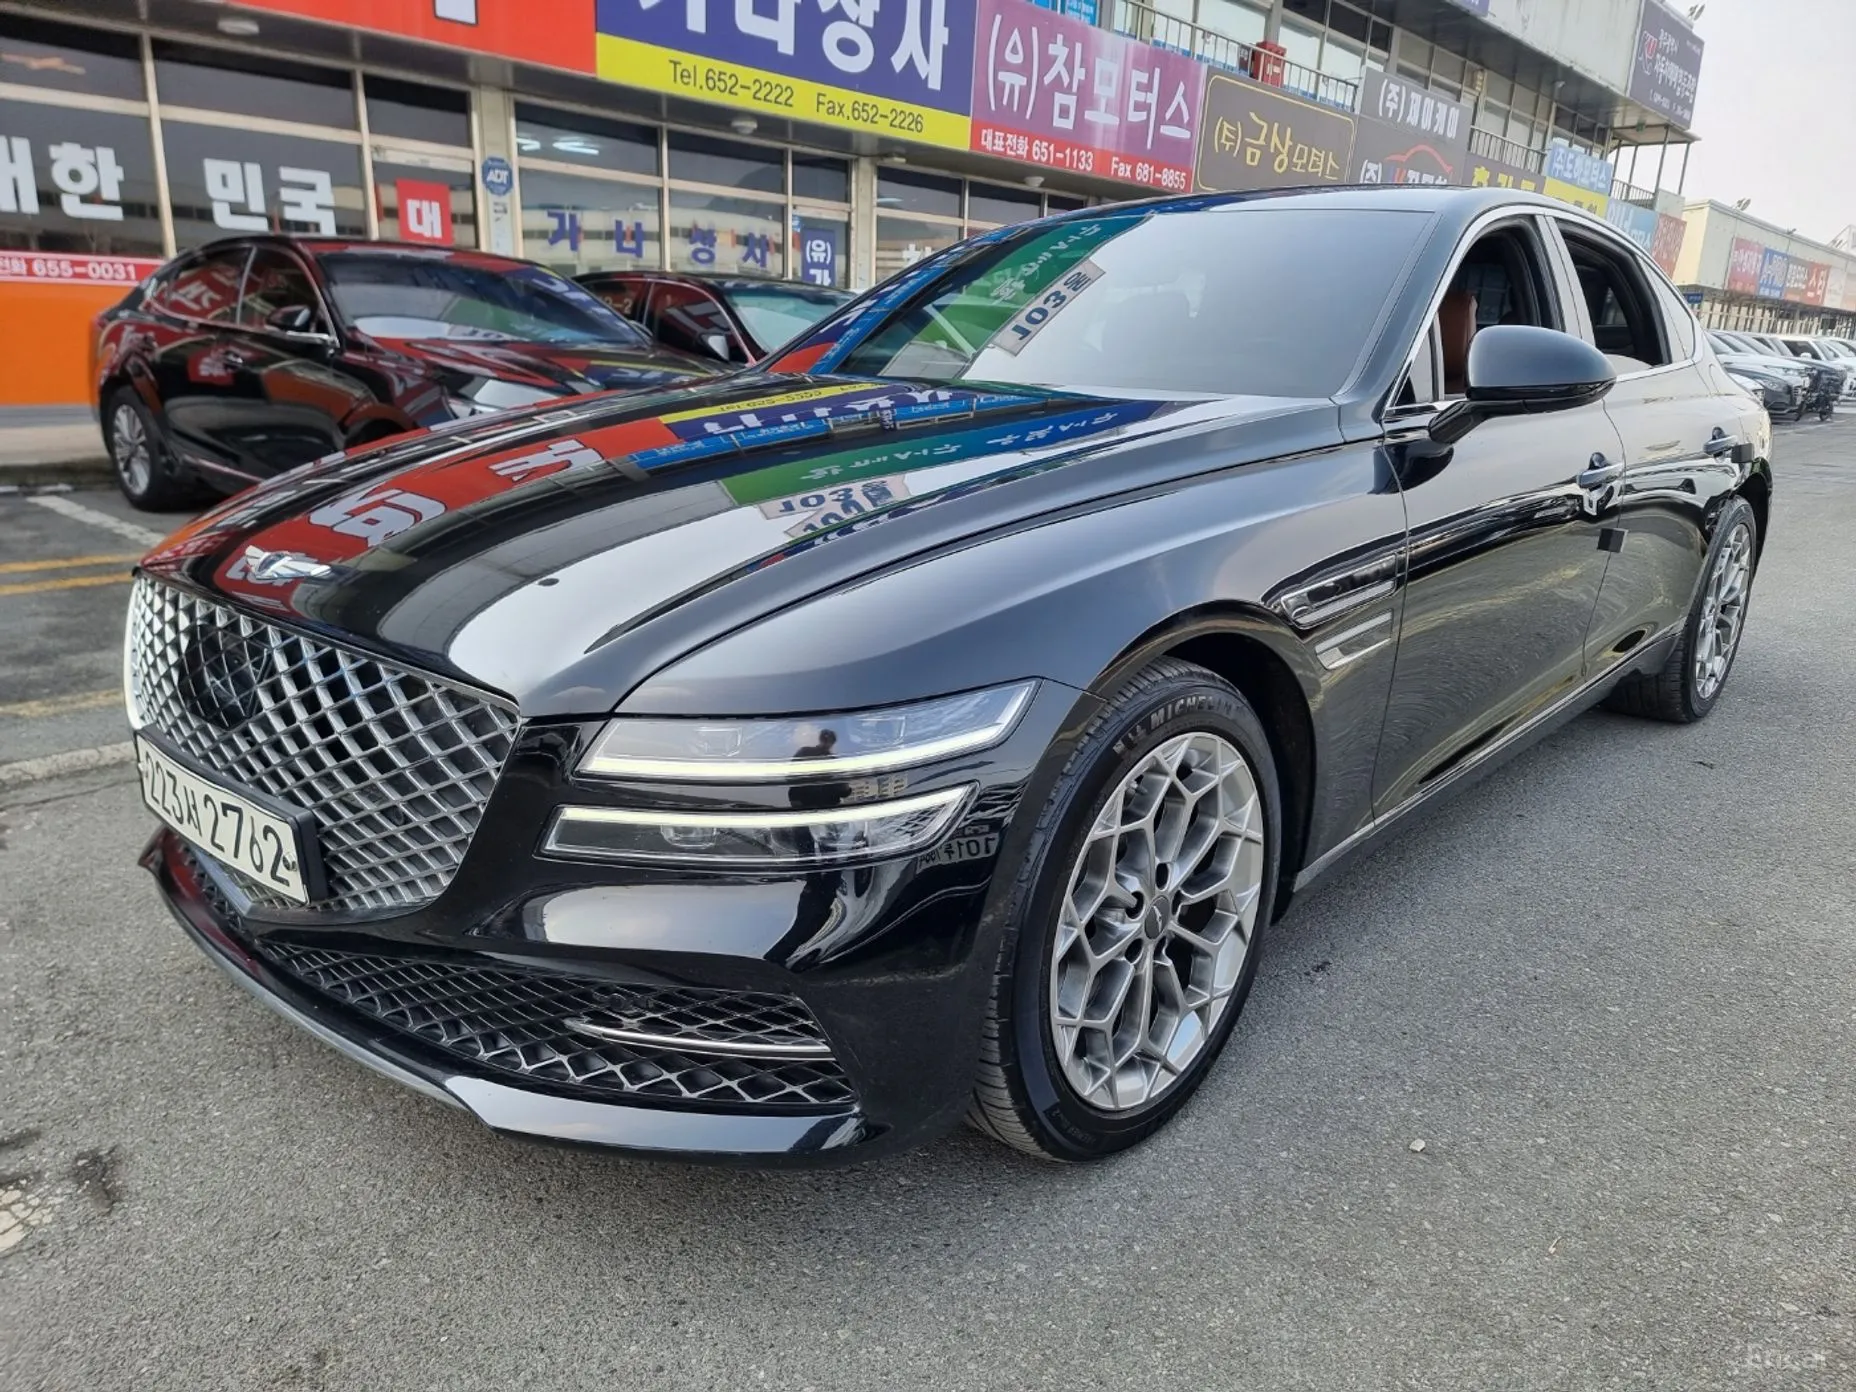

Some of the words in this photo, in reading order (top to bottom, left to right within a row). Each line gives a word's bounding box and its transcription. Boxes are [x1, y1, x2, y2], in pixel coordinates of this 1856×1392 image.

[668, 59, 794, 108] Tel.652-2222
[816, 92, 924, 134] Fax.652-2226
[486, 168, 508, 184] ADT
[980, 128, 1028, 159] 대표전화
[1032, 139, 1094, 172] 651-1133
[1111, 156, 1132, 179] Fax
[1136, 162, 1186, 190] 681-8855
[32, 258, 136, 281] 655-0031
